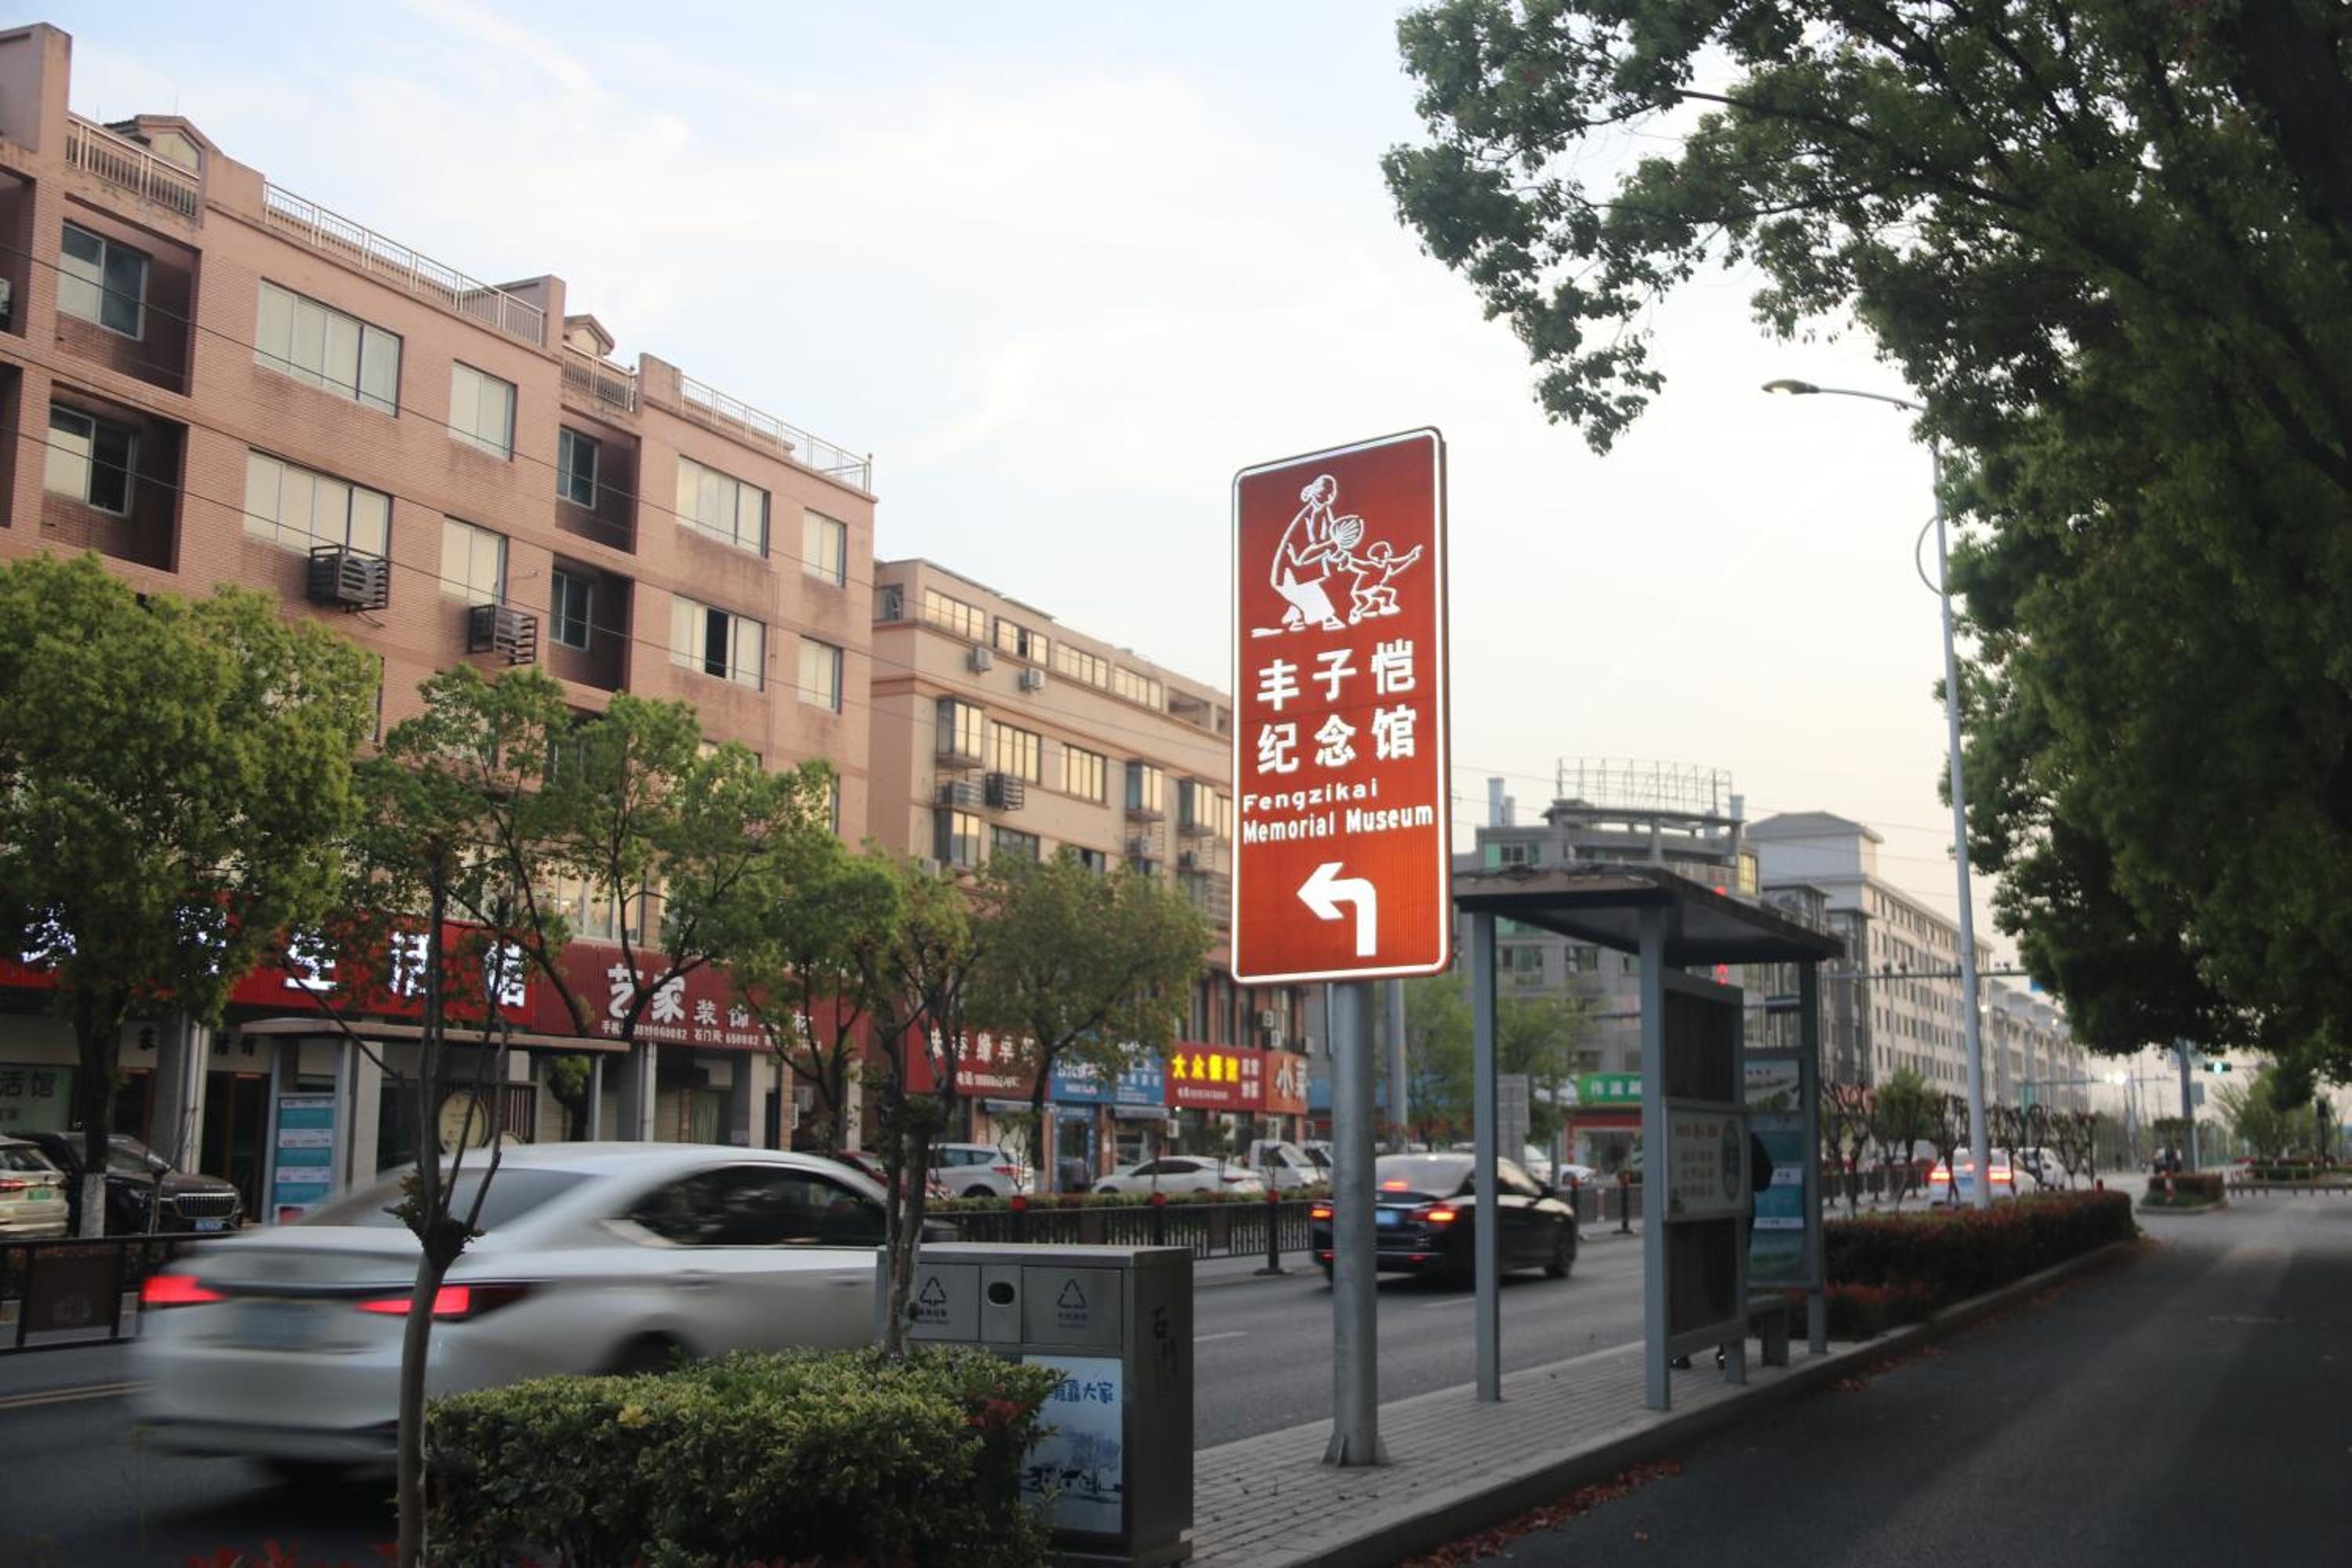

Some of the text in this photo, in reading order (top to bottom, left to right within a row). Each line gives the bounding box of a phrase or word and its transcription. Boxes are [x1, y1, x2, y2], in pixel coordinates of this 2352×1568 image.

[1257, 638, 1417, 711] 丰子恺
[1257, 704, 1417, 775] 纪念馆
[1243, 778, 1377, 813] Fengzikai
[1243, 804, 1433, 844] Memorial Museum
